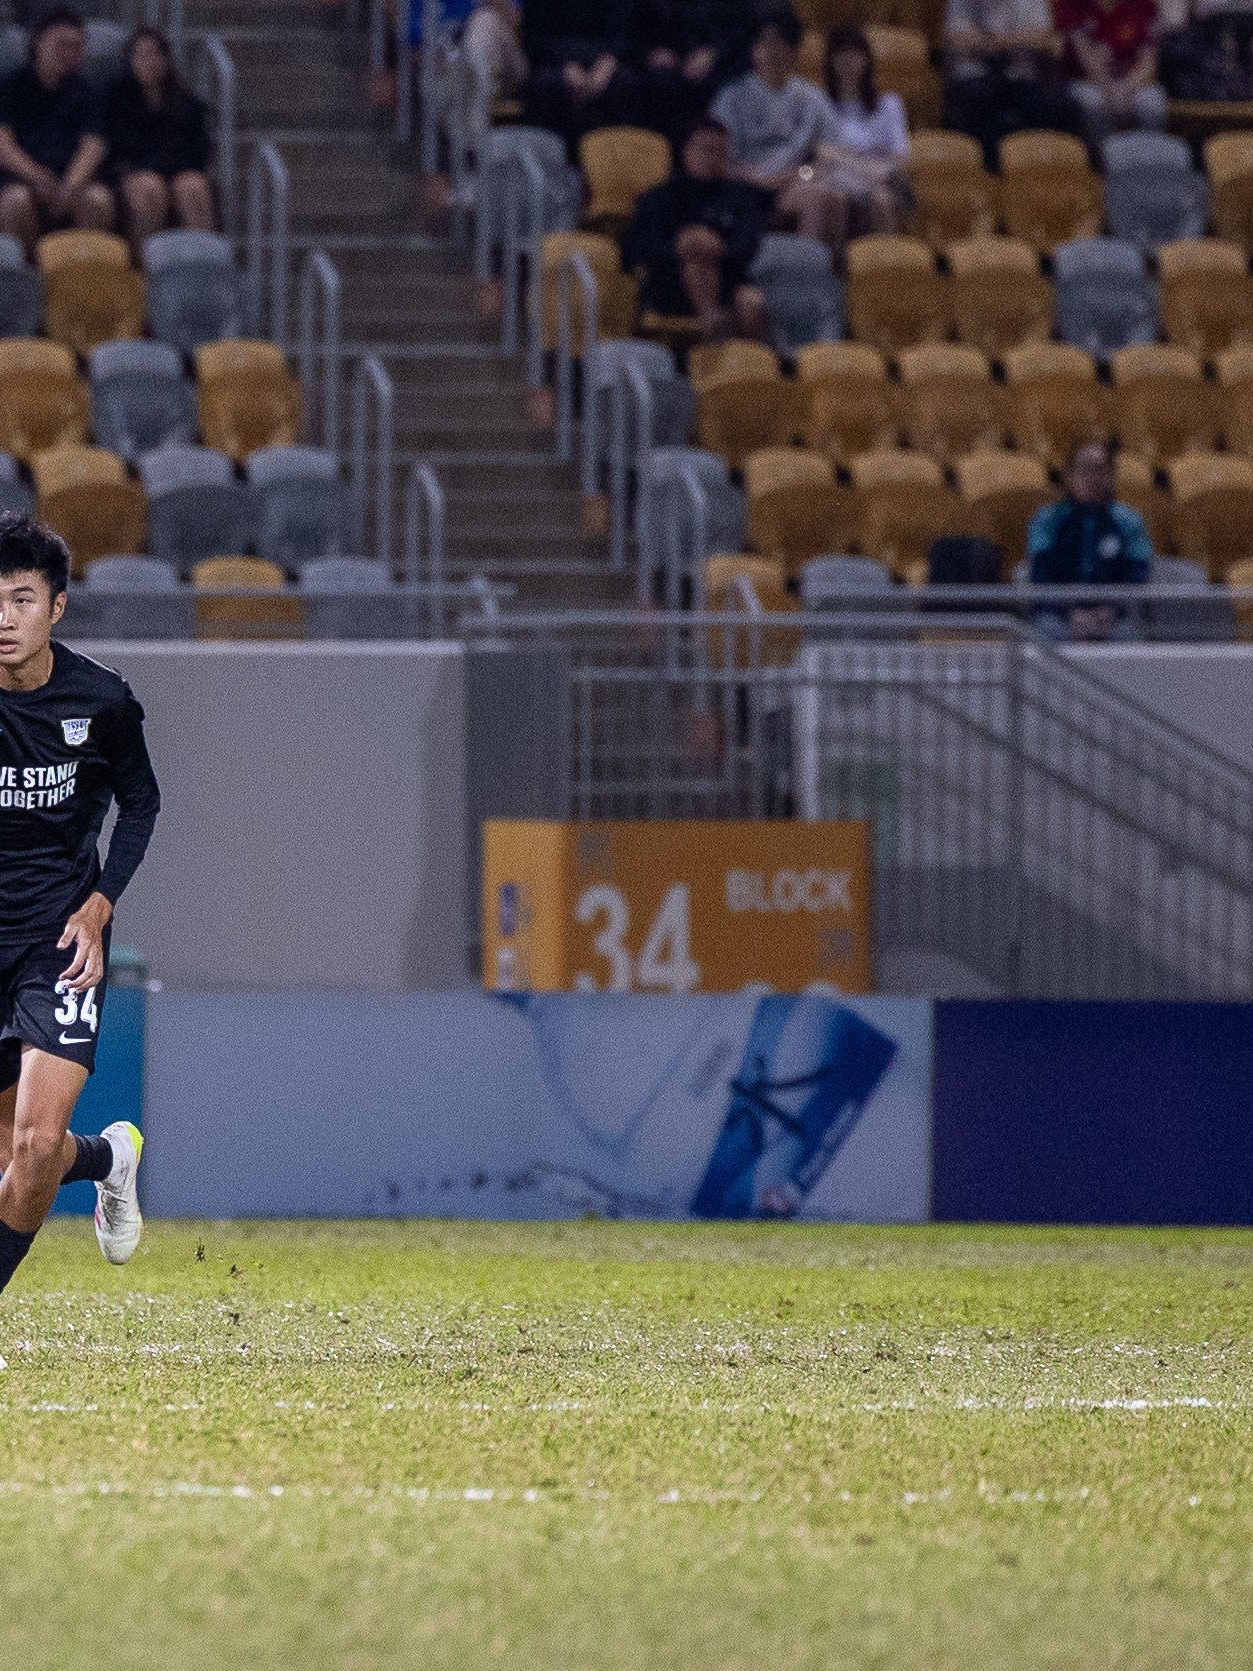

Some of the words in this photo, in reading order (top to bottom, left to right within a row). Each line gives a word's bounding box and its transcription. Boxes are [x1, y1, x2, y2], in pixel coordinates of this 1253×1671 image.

[23, 760, 79, 788] STAND
[725, 867, 853, 913] BLOCK
[574, 881, 701, 994] 34
[54, 979, 98, 1033] 34
